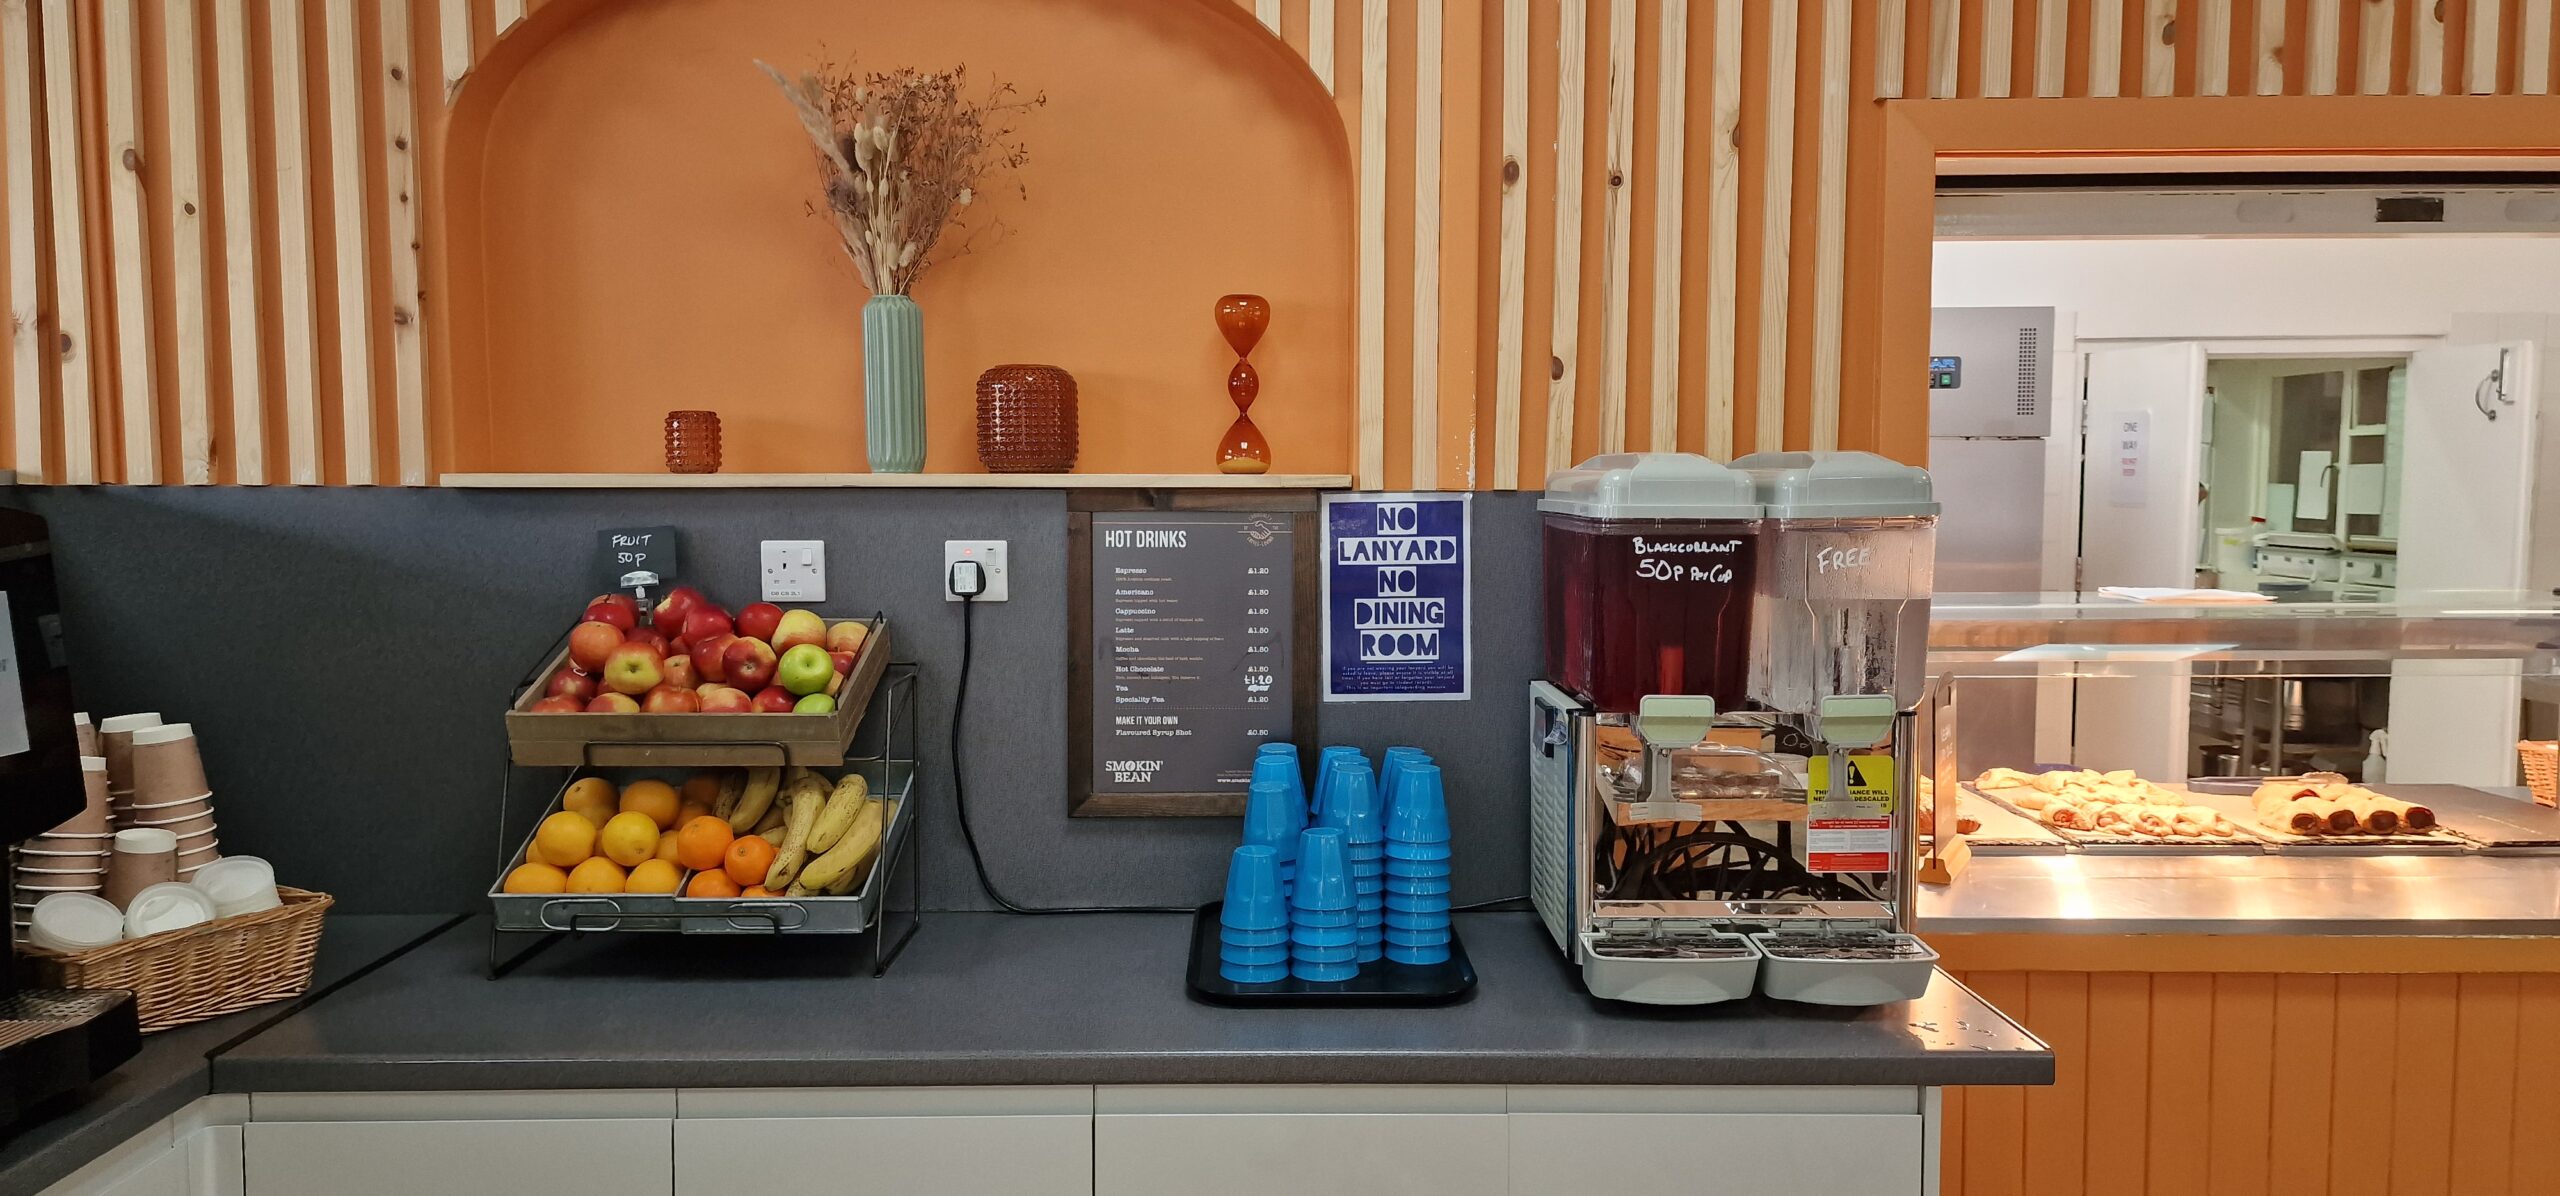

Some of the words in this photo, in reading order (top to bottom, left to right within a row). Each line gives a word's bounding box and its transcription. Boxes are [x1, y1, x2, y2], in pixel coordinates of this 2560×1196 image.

[2123, 422, 2138, 432] ONE
[1378, 507, 1416, 531] NO
[612, 534, 652, 548] FRUIT
[1105, 530, 1132, 548] HOT
[1136, 530, 1187, 548] DRINKS
[1632, 536, 1742, 554] BLACKCURRANT
[1340, 540, 1456, 562] LANYARD
[1816, 546, 1872, 574] FREE
[1115, 567, 1147, 575] Espresso
[1379, 570, 1416, 593] NO
[1115, 608, 1156, 616] Cappuccino
[1356, 602, 1444, 625] DINING
[1362, 633, 1438, 656] ROOM
[1244, 674, 1273, 685] £1.20
[1115, 696, 1150, 704] Speciality
[1115, 716, 1135, 725] MAKE
[1136, 716, 1142, 725] IT
[1144, 716, 1161, 725] YOUR
[1162, 716, 1178, 725] OWN
[1105, 760, 1163, 772] SMOKIN'
[1114, 772, 1151, 783] BEAN
